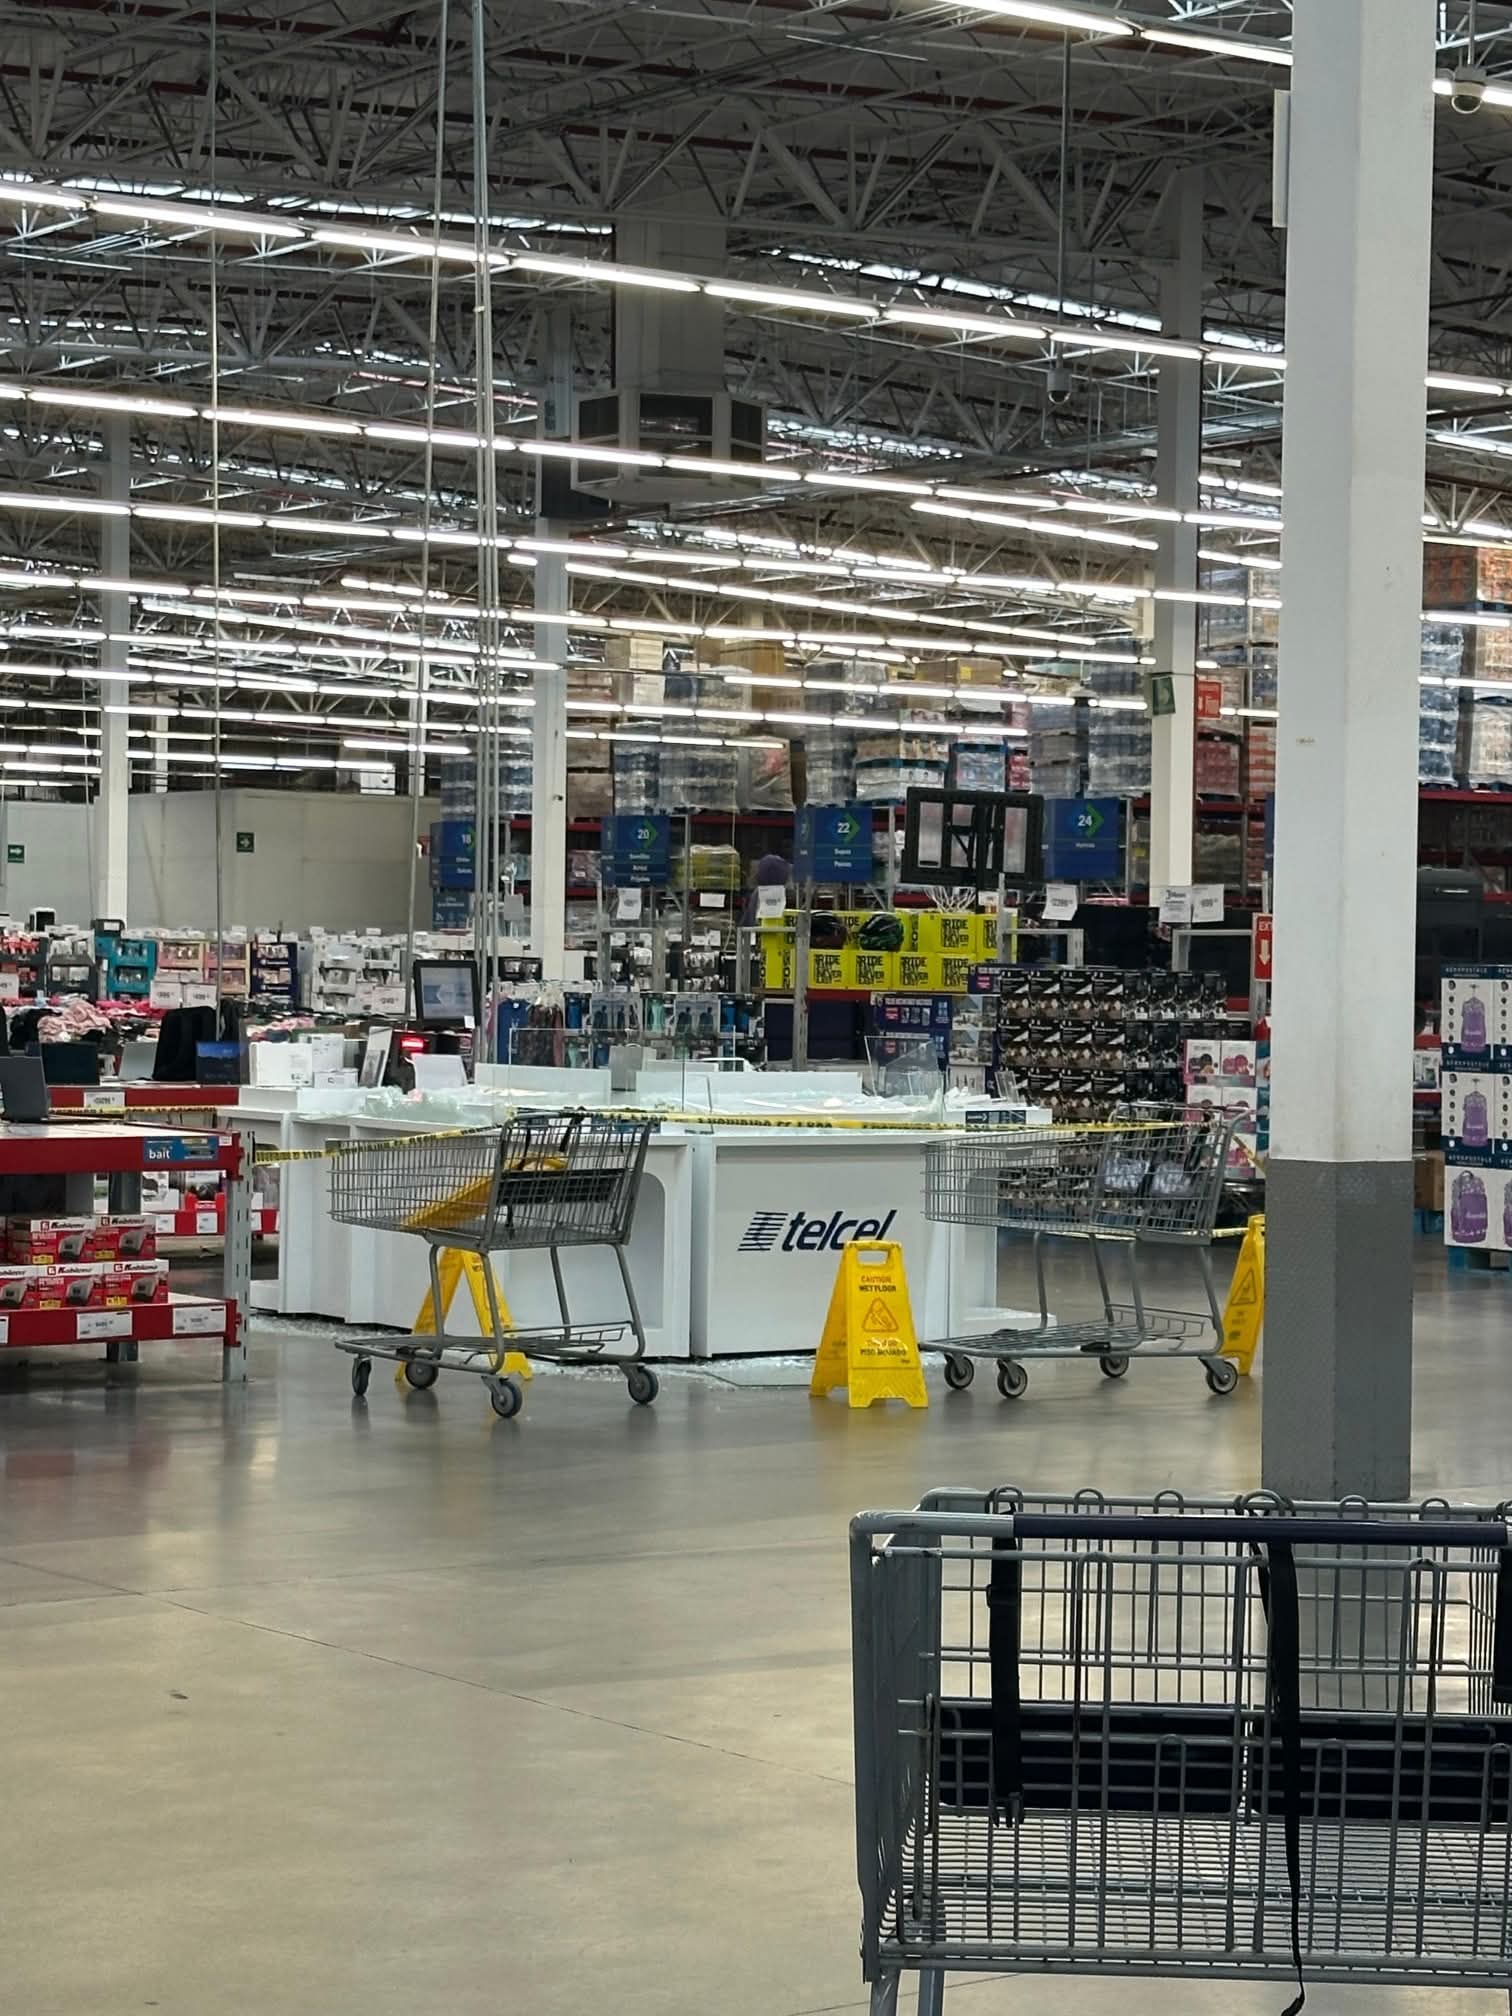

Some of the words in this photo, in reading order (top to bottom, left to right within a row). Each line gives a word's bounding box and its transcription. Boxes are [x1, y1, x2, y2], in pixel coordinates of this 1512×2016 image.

[1077, 814, 1093, 827] 24
[837, 822, 850, 833] 22
[637, 828, 650, 840] 20
[149, 1147, 170, 1159] bait
[781, 1209, 898, 1251] telcel
